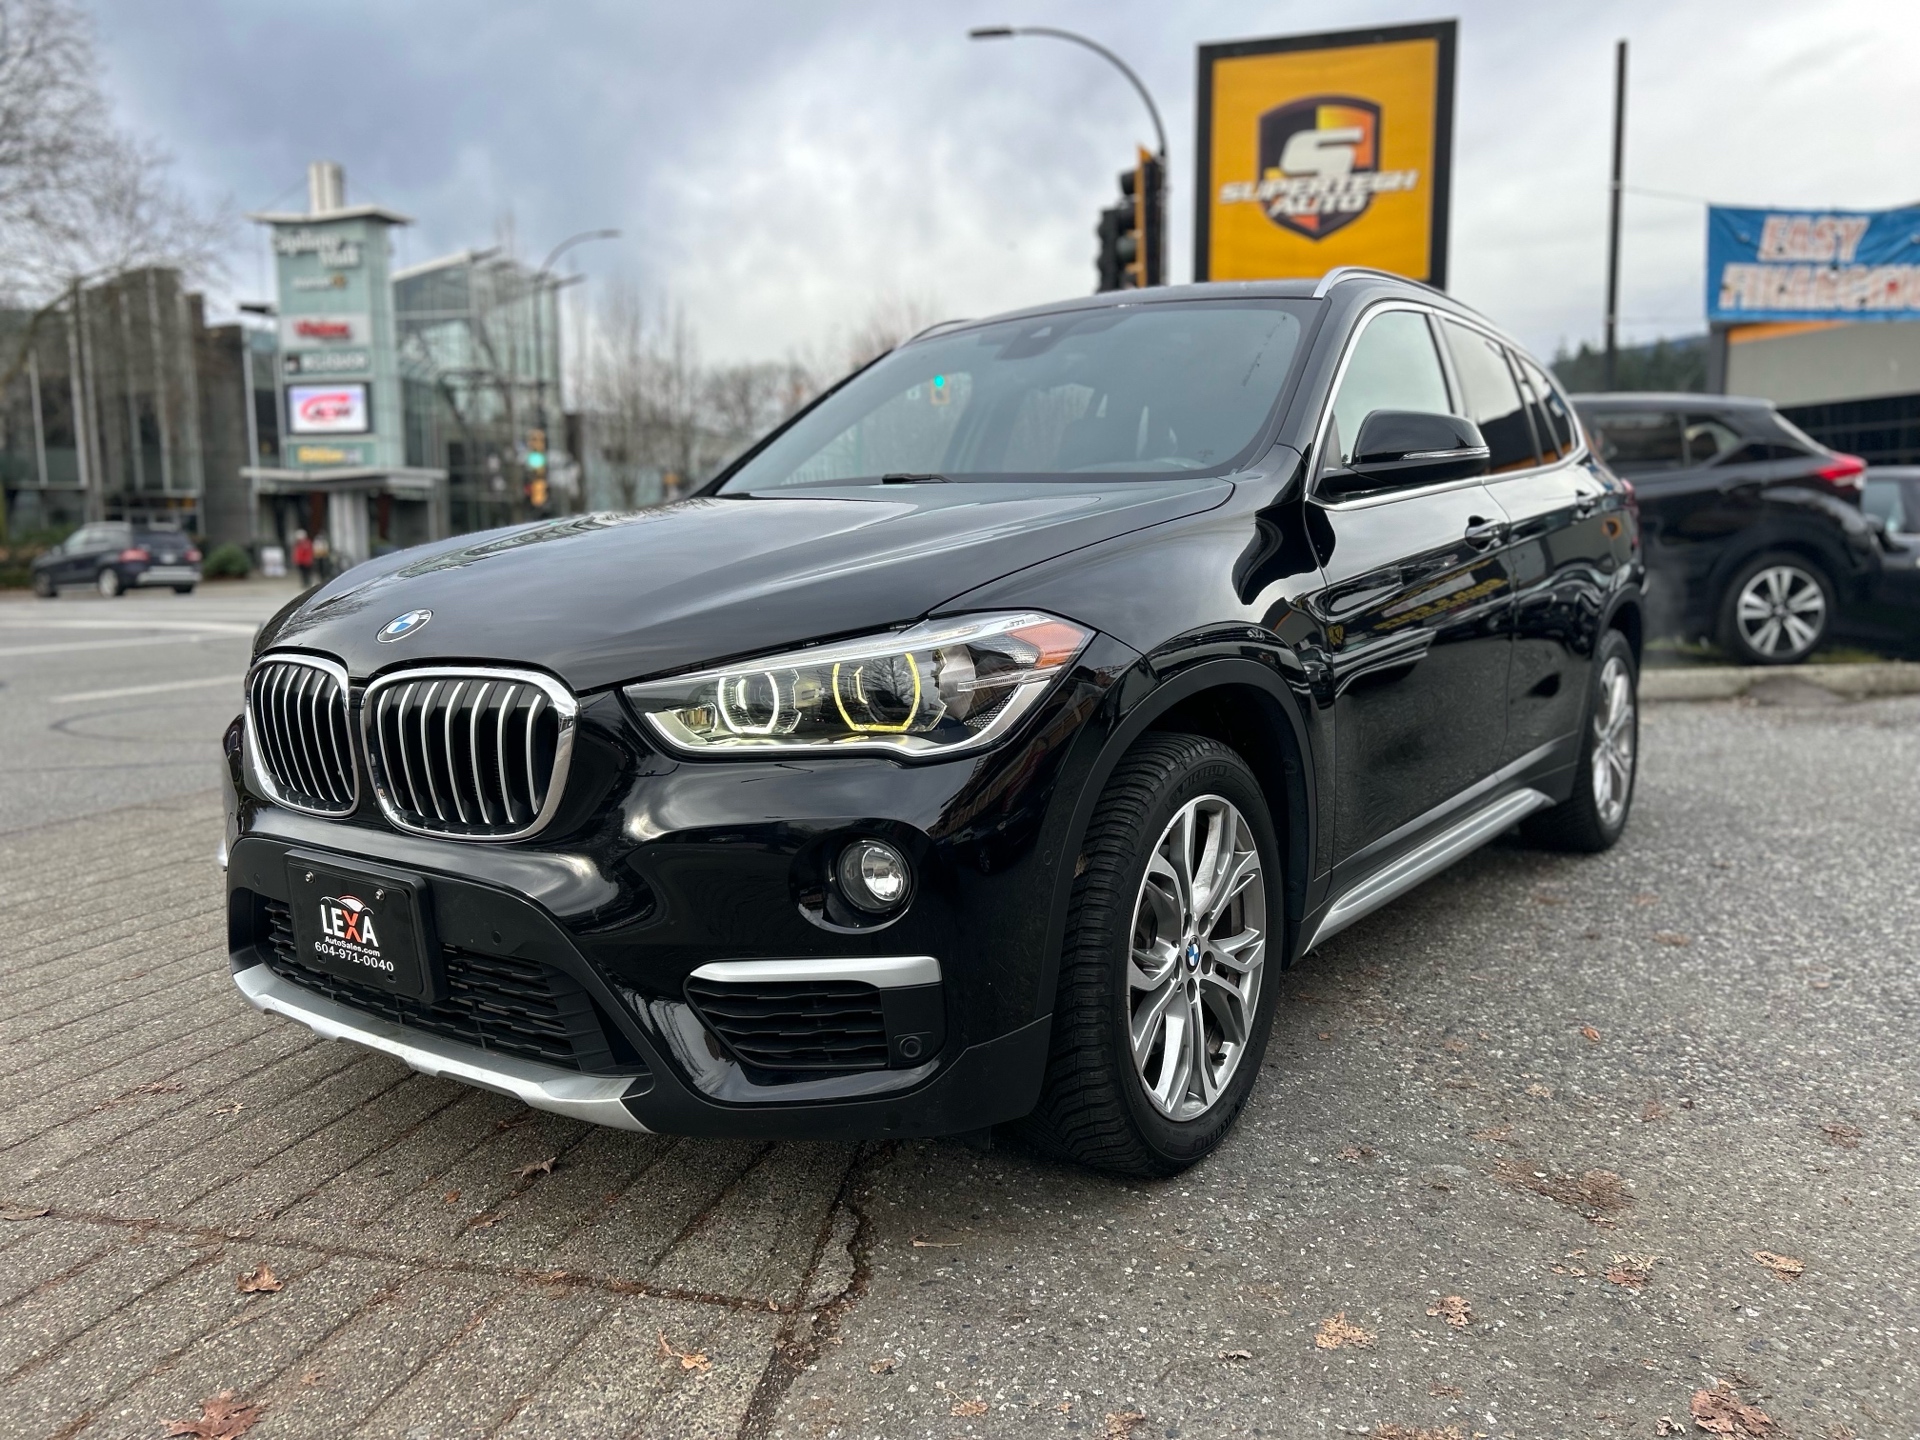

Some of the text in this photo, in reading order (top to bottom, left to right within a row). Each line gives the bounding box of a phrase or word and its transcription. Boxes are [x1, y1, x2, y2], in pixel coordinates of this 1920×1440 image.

[1268, 192, 1369, 218] AUTO
[1757, 215, 1871, 263] EASY
[320, 904, 379, 948] LEXA
[315, 941, 395, 972] 604-971-0040
[324, 936, 381, 957] AutoSales.com
